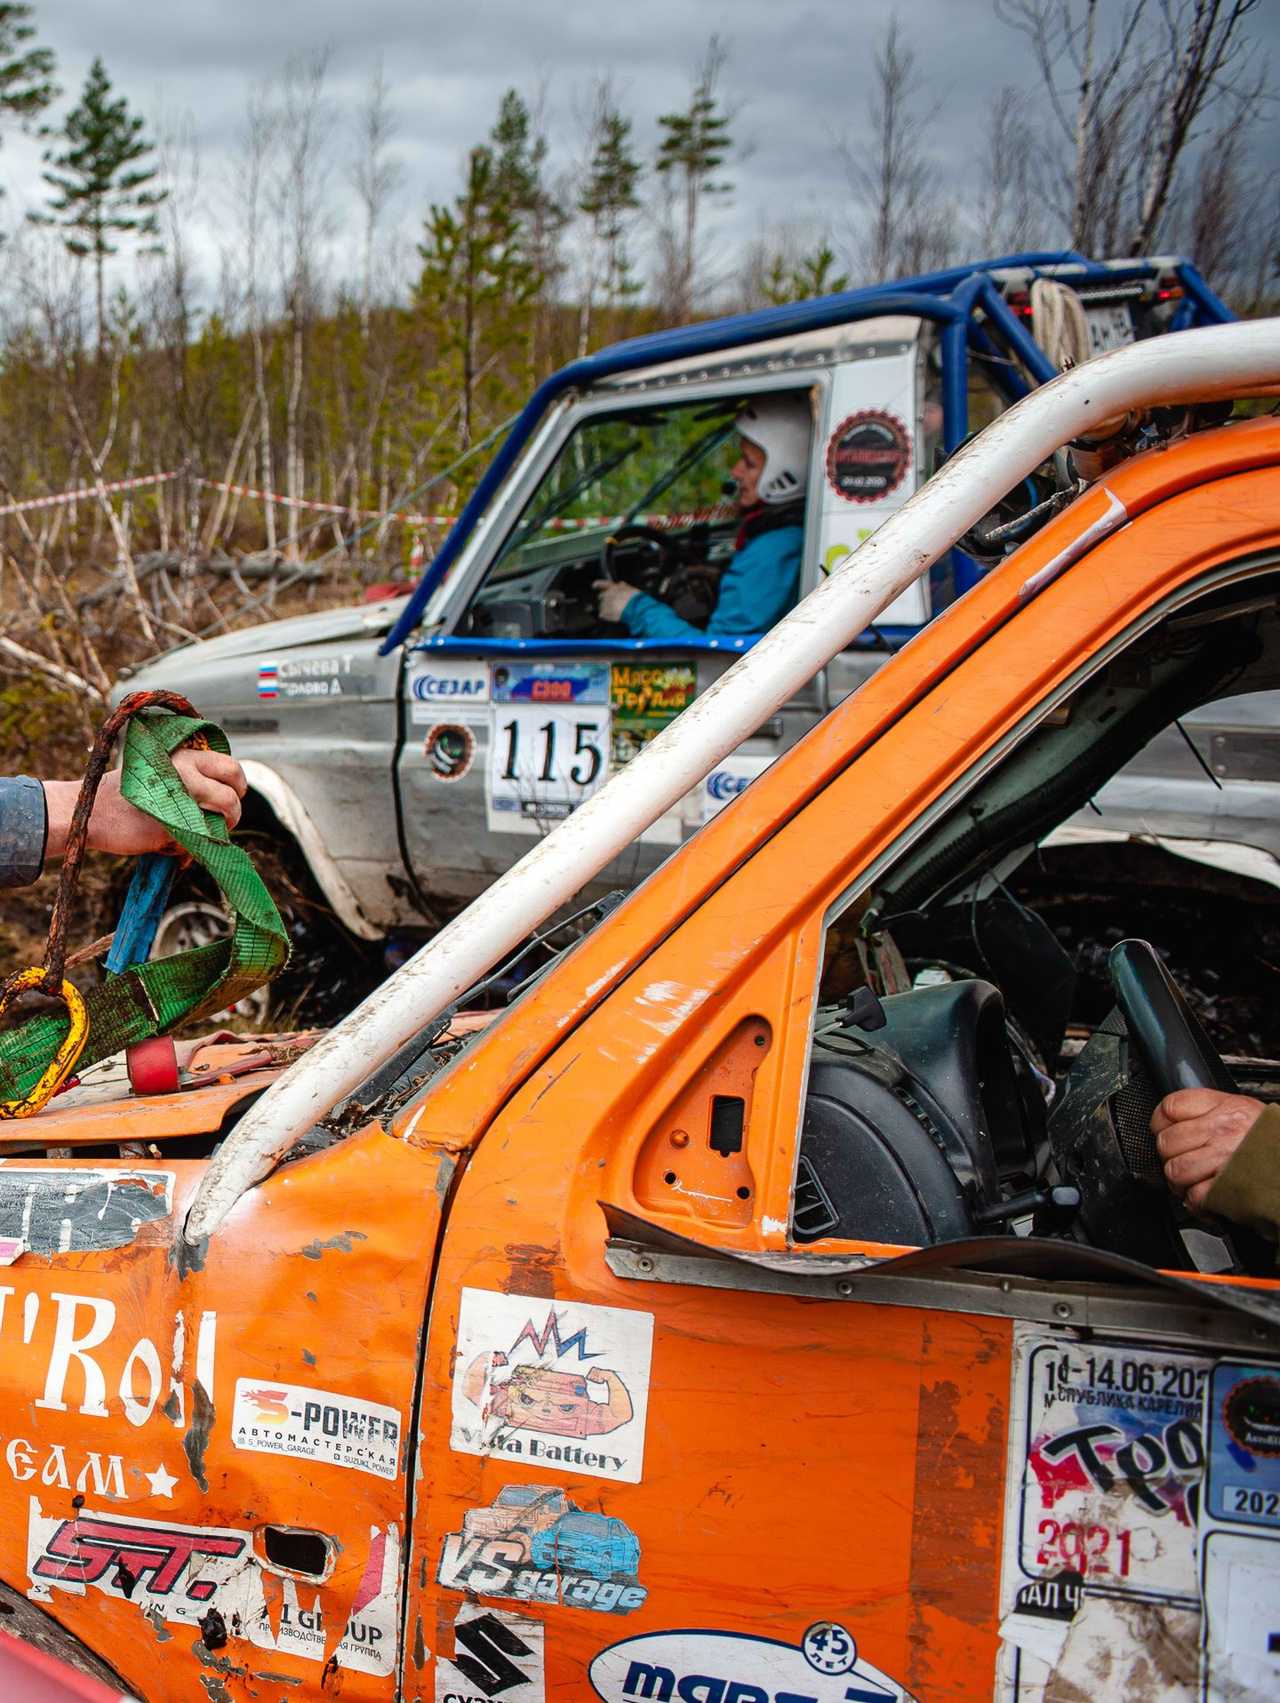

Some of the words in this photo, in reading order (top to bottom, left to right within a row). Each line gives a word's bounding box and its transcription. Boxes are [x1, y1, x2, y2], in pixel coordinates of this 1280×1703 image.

[342, 654, 355, 674] Т
[419, 677, 486, 697] СЕЗАР
[501, 719, 603, 787] 115
[238, 1426, 397, 1467] АВТОМАСТЕРСКАЯ
[247, 1438, 317, 1456] S_POWER_GARAGE
[528, 1438, 628, 1472] Battery
[434, 1531, 526, 1592] VS
[1036, 1518, 1132, 1578] 2021
[512, 1569, 648, 1612] garage
[350, 1644, 382, 1660] ГРУППА
[809, 1627, 850, 1656] 45
[809, 1652, 849, 1670] ЛЕТ
